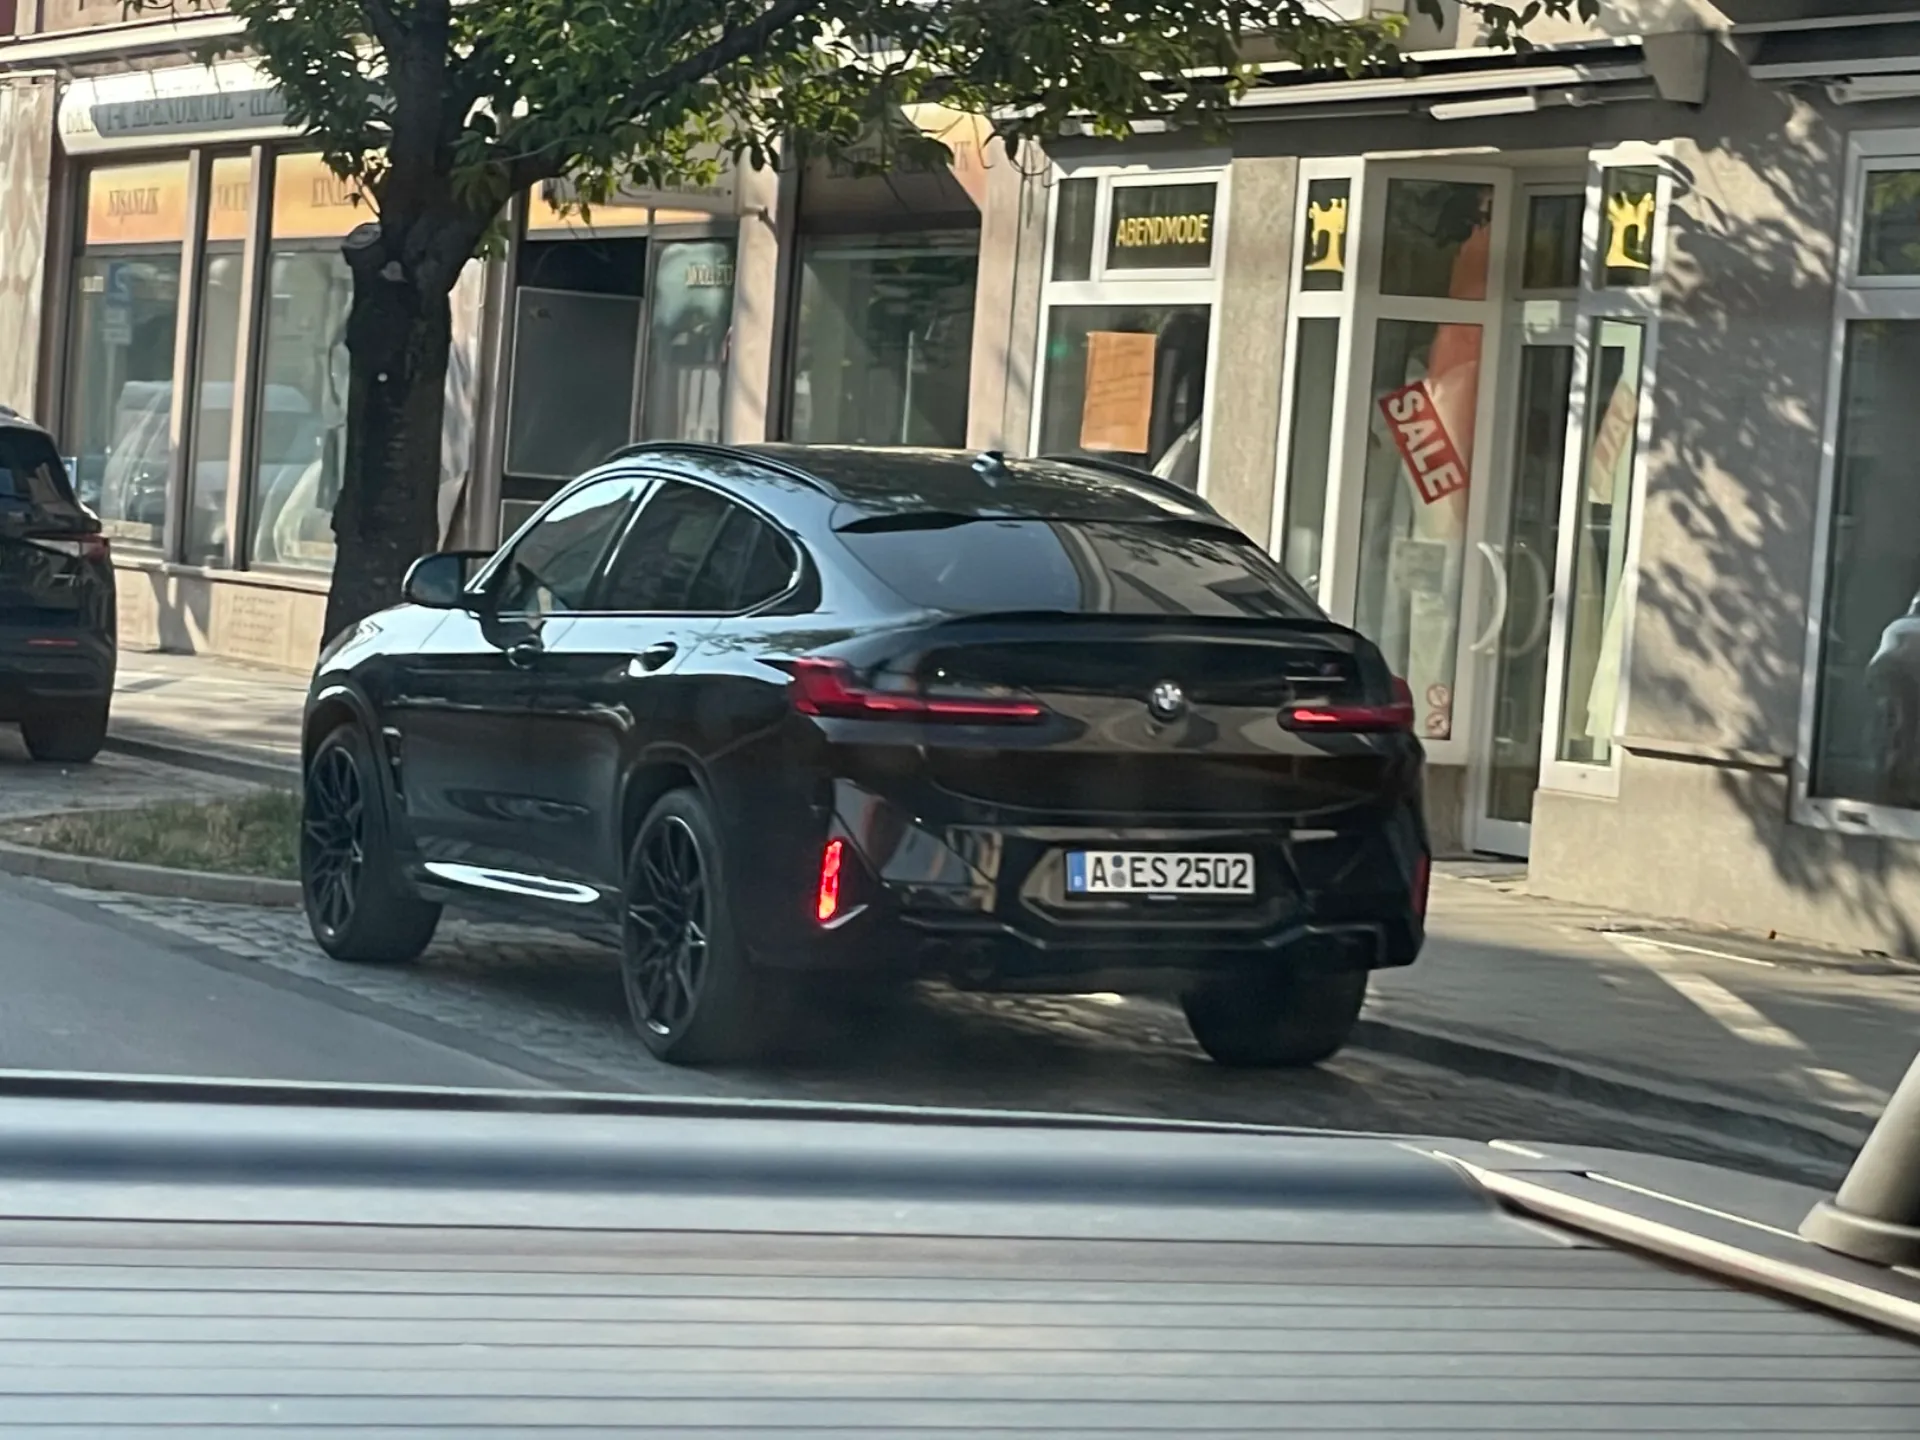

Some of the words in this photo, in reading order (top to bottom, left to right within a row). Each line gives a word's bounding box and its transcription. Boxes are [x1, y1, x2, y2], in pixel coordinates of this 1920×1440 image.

[1116, 213, 1209, 247] ABENDMODE
[1387, 389, 1464, 499] SALE
[1091, 856, 1110, 888] A
[1129, 856, 1169, 888] ES
[1175, 857, 1249, 889] 2502
